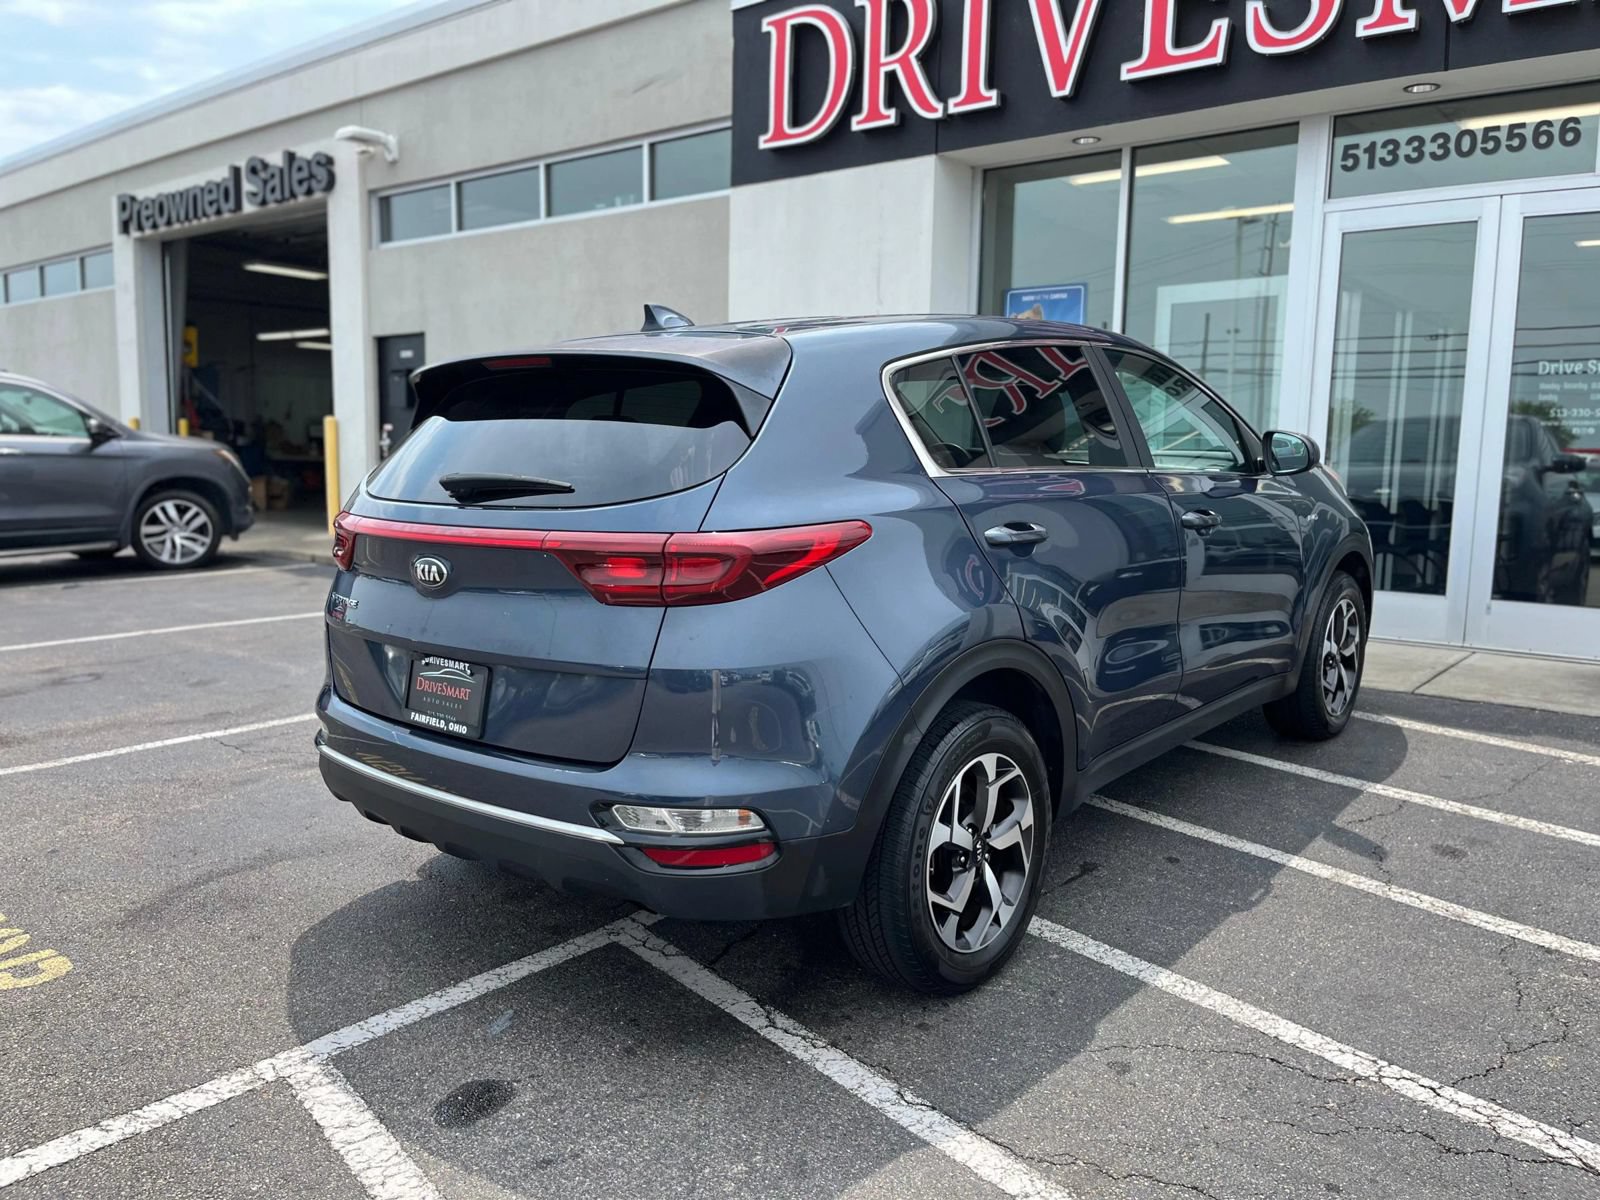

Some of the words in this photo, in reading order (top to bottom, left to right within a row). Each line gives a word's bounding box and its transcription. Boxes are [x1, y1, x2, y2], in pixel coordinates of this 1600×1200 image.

[758, 0, 1577, 149] DRIVE
[1340, 116, 1582, 172] 5133305566
[117, 166, 242, 236] Preowned
[246, 149, 336, 206] Sales
[1538, 359, 1583, 376] Drive
[415, 563, 440, 582] KIA
[410, 711, 447, 731] FAIRFIELD,
[448, 722, 468, 734] OHIO
